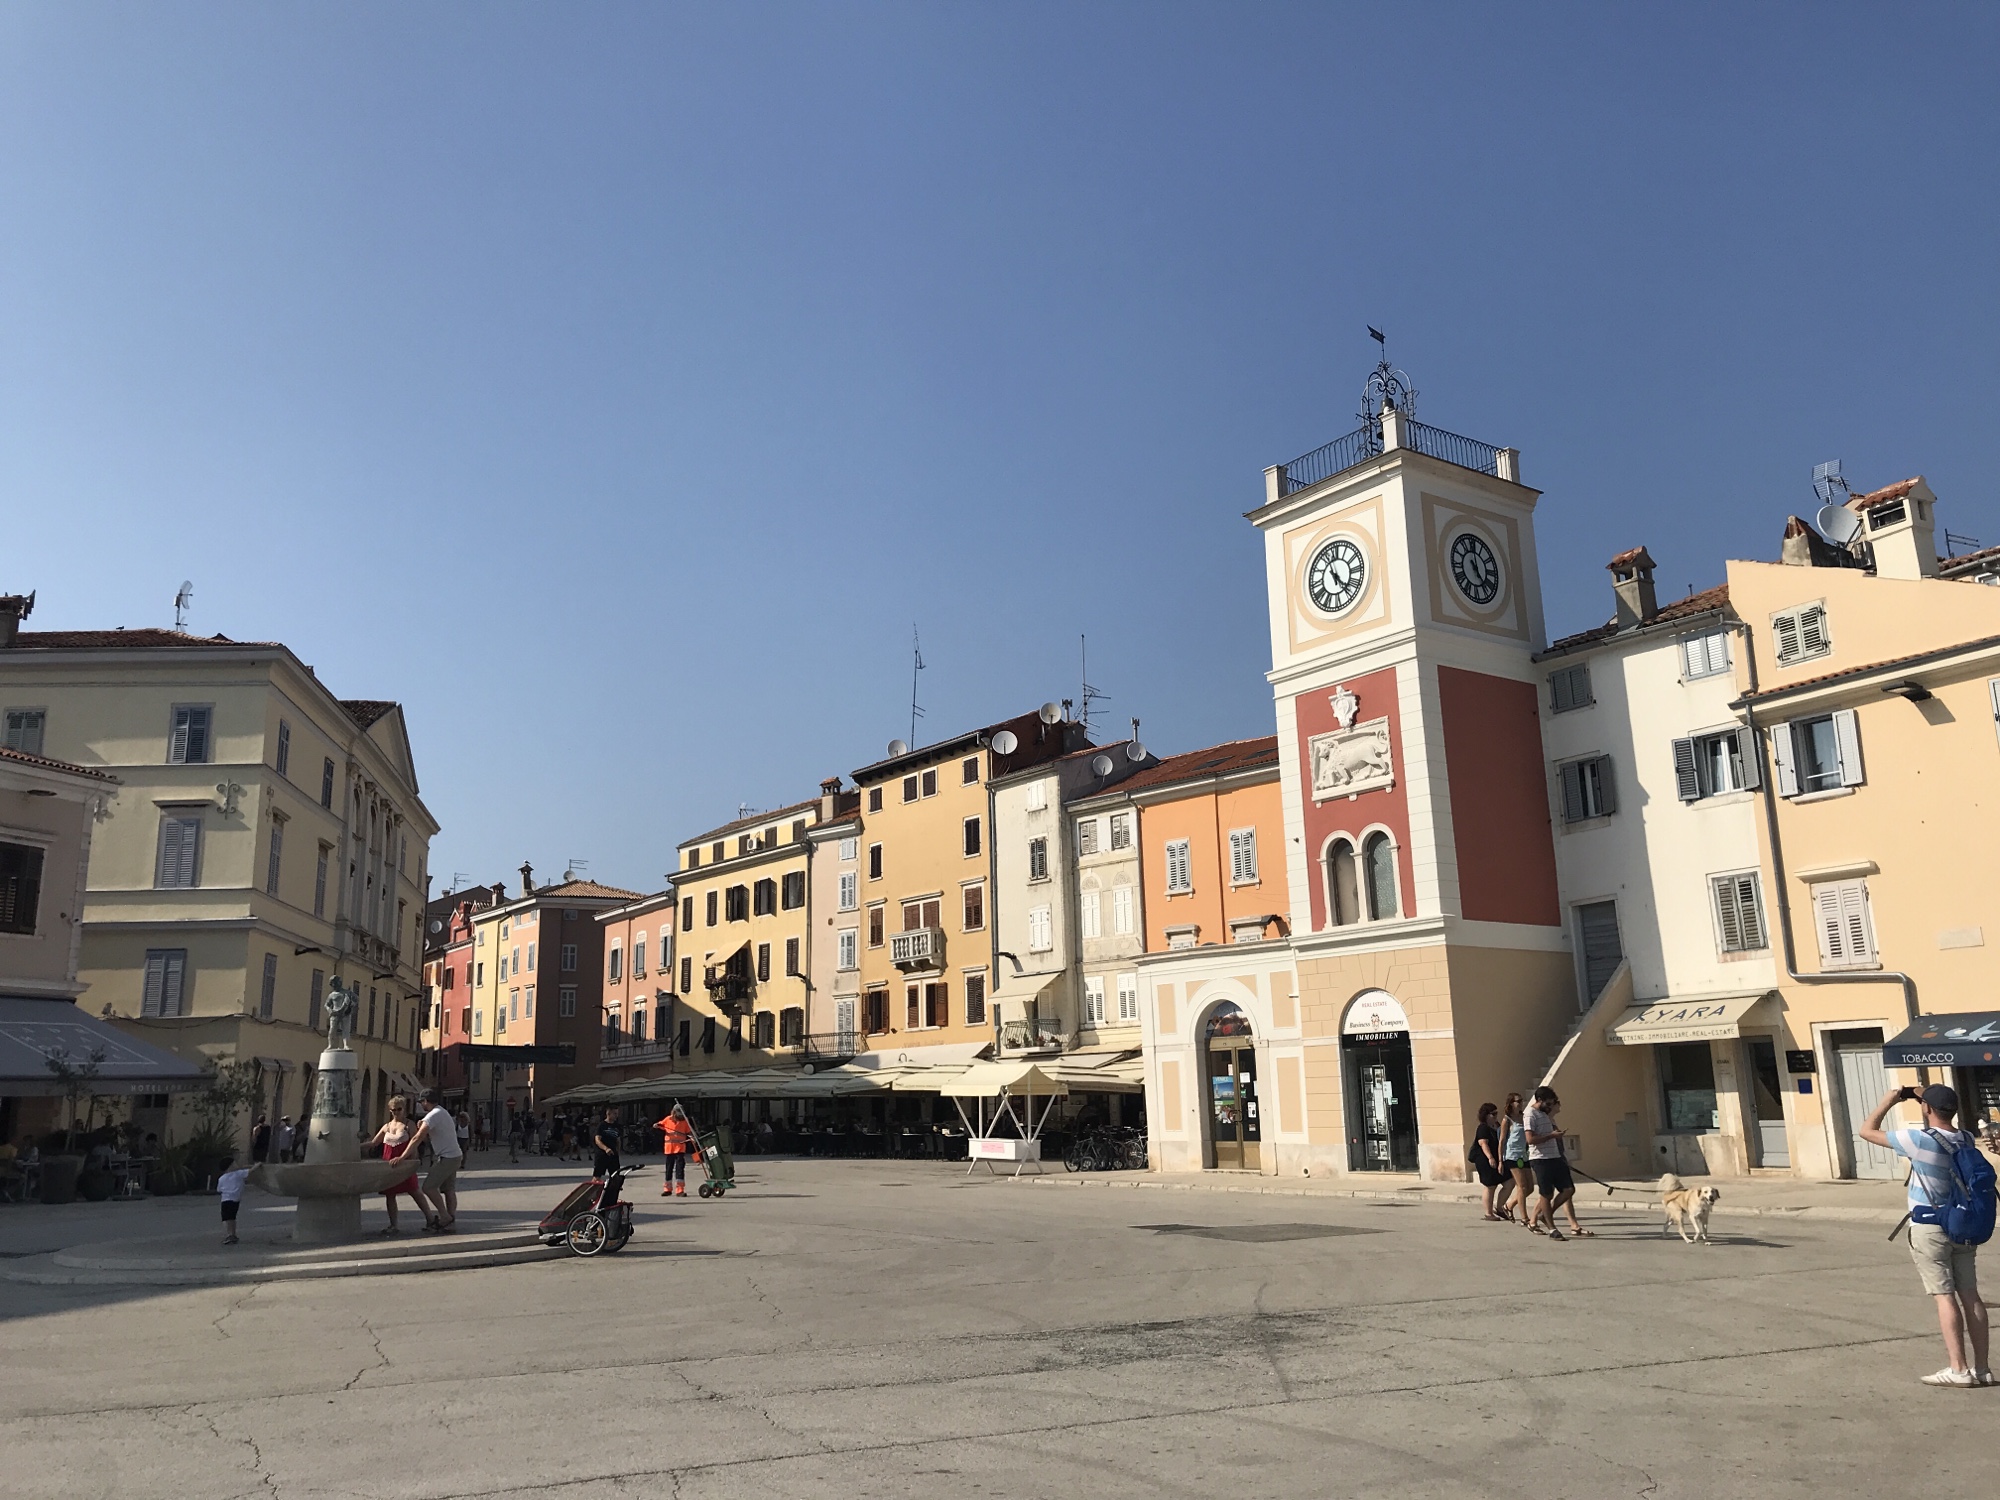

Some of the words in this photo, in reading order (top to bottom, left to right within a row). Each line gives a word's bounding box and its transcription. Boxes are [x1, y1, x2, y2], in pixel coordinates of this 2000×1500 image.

[1633, 1005, 1725, 1022] KYARA
[1355, 1033, 1399, 1041] IMMOBILIEN
[1902, 1052, 1954, 1063] TOBACCO
[130, 1084, 162, 1092] HOTEL
